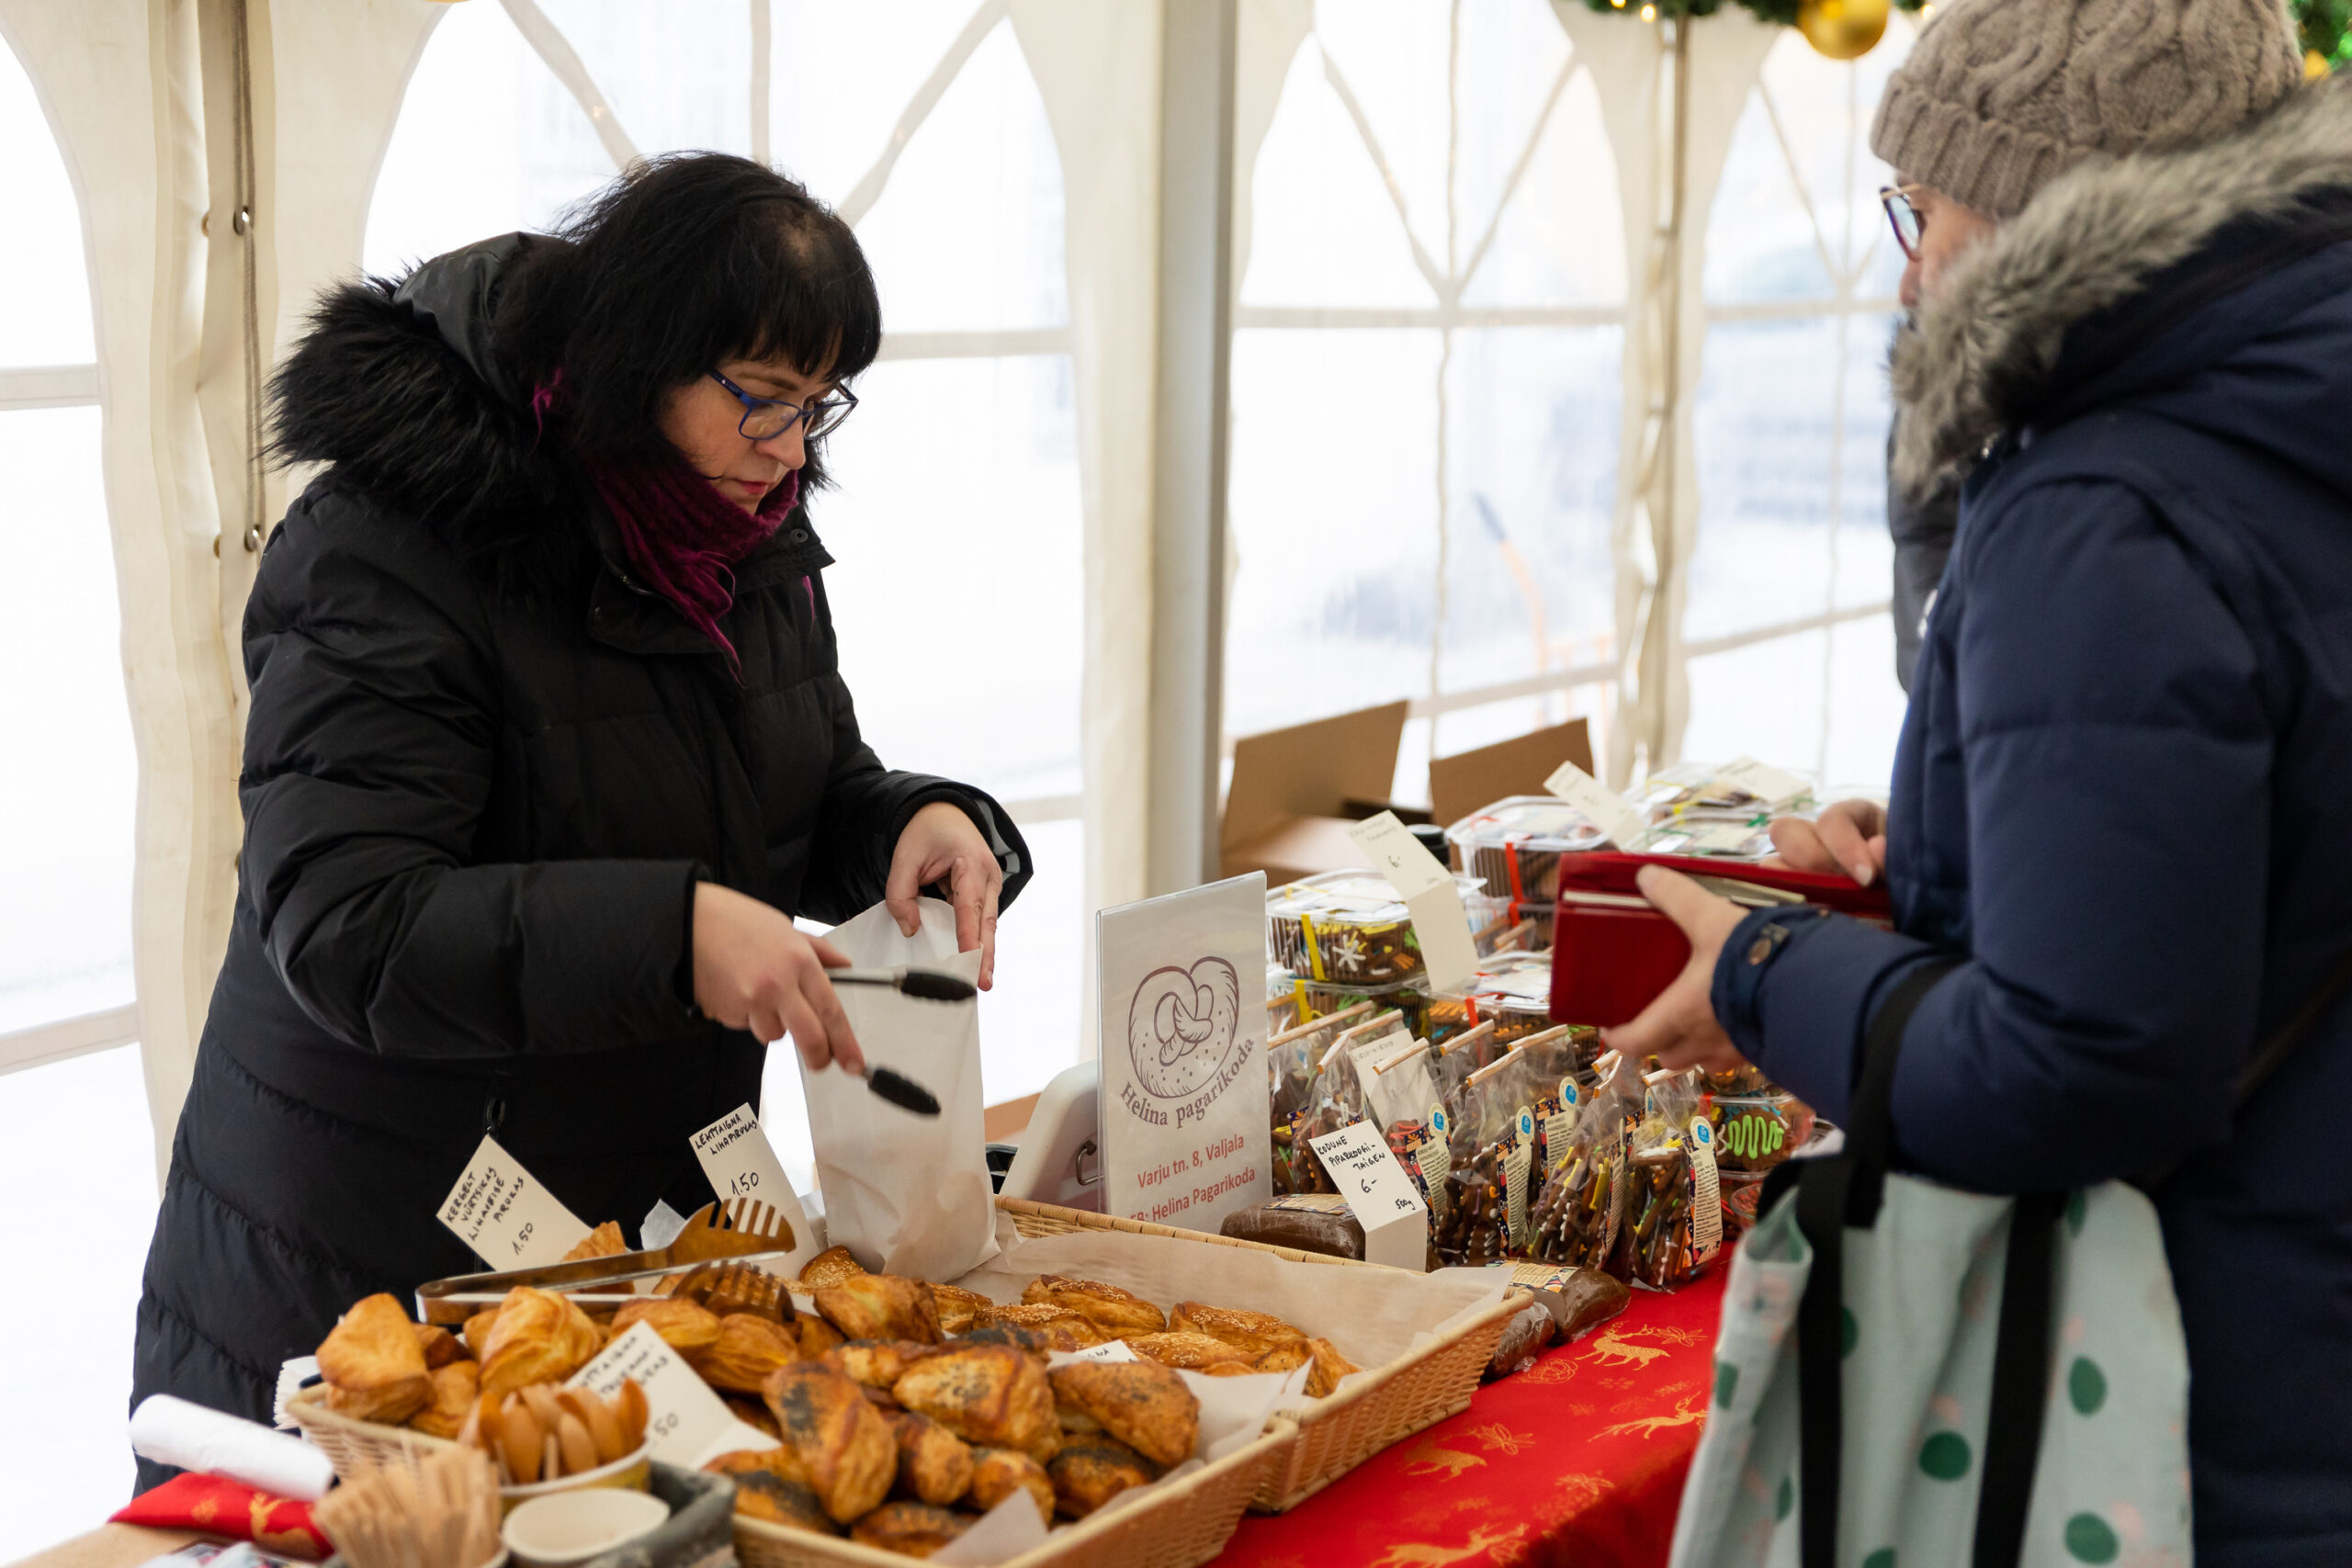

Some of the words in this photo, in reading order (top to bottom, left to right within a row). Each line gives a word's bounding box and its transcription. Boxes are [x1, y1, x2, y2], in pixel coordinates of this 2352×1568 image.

[1120, 1080, 1168, 1126] Helina
[1176, 1038, 1254, 1129] pagarikoda
[695, 1113, 741, 1149] LEHTTAIGNA
[710, 1120, 757, 1155] LIHAPIRUKAS
[1316, 1135, 1348, 1155] KODUNE
[1137, 1162, 1170, 1189] Varju
[1172, 1159, 1189, 1175] tn.
[1192, 1150, 1203, 1168] 8,
[1205, 1134, 1244, 1161] Valjala
[446, 1171, 477, 1223] KERGELT
[461, 1166, 497, 1222] VÜRTSIKAS
[493, 1177, 524, 1223] PIRUKAS
[730, 1171, 759, 1196] 1.50
[1152, 1197, 1190, 1222] Helina
[1193, 1167, 1255, 1203] Pagarikoda
[1395, 1198, 1416, 1211] 500g
[512, 1222, 534, 1256] 1.50
